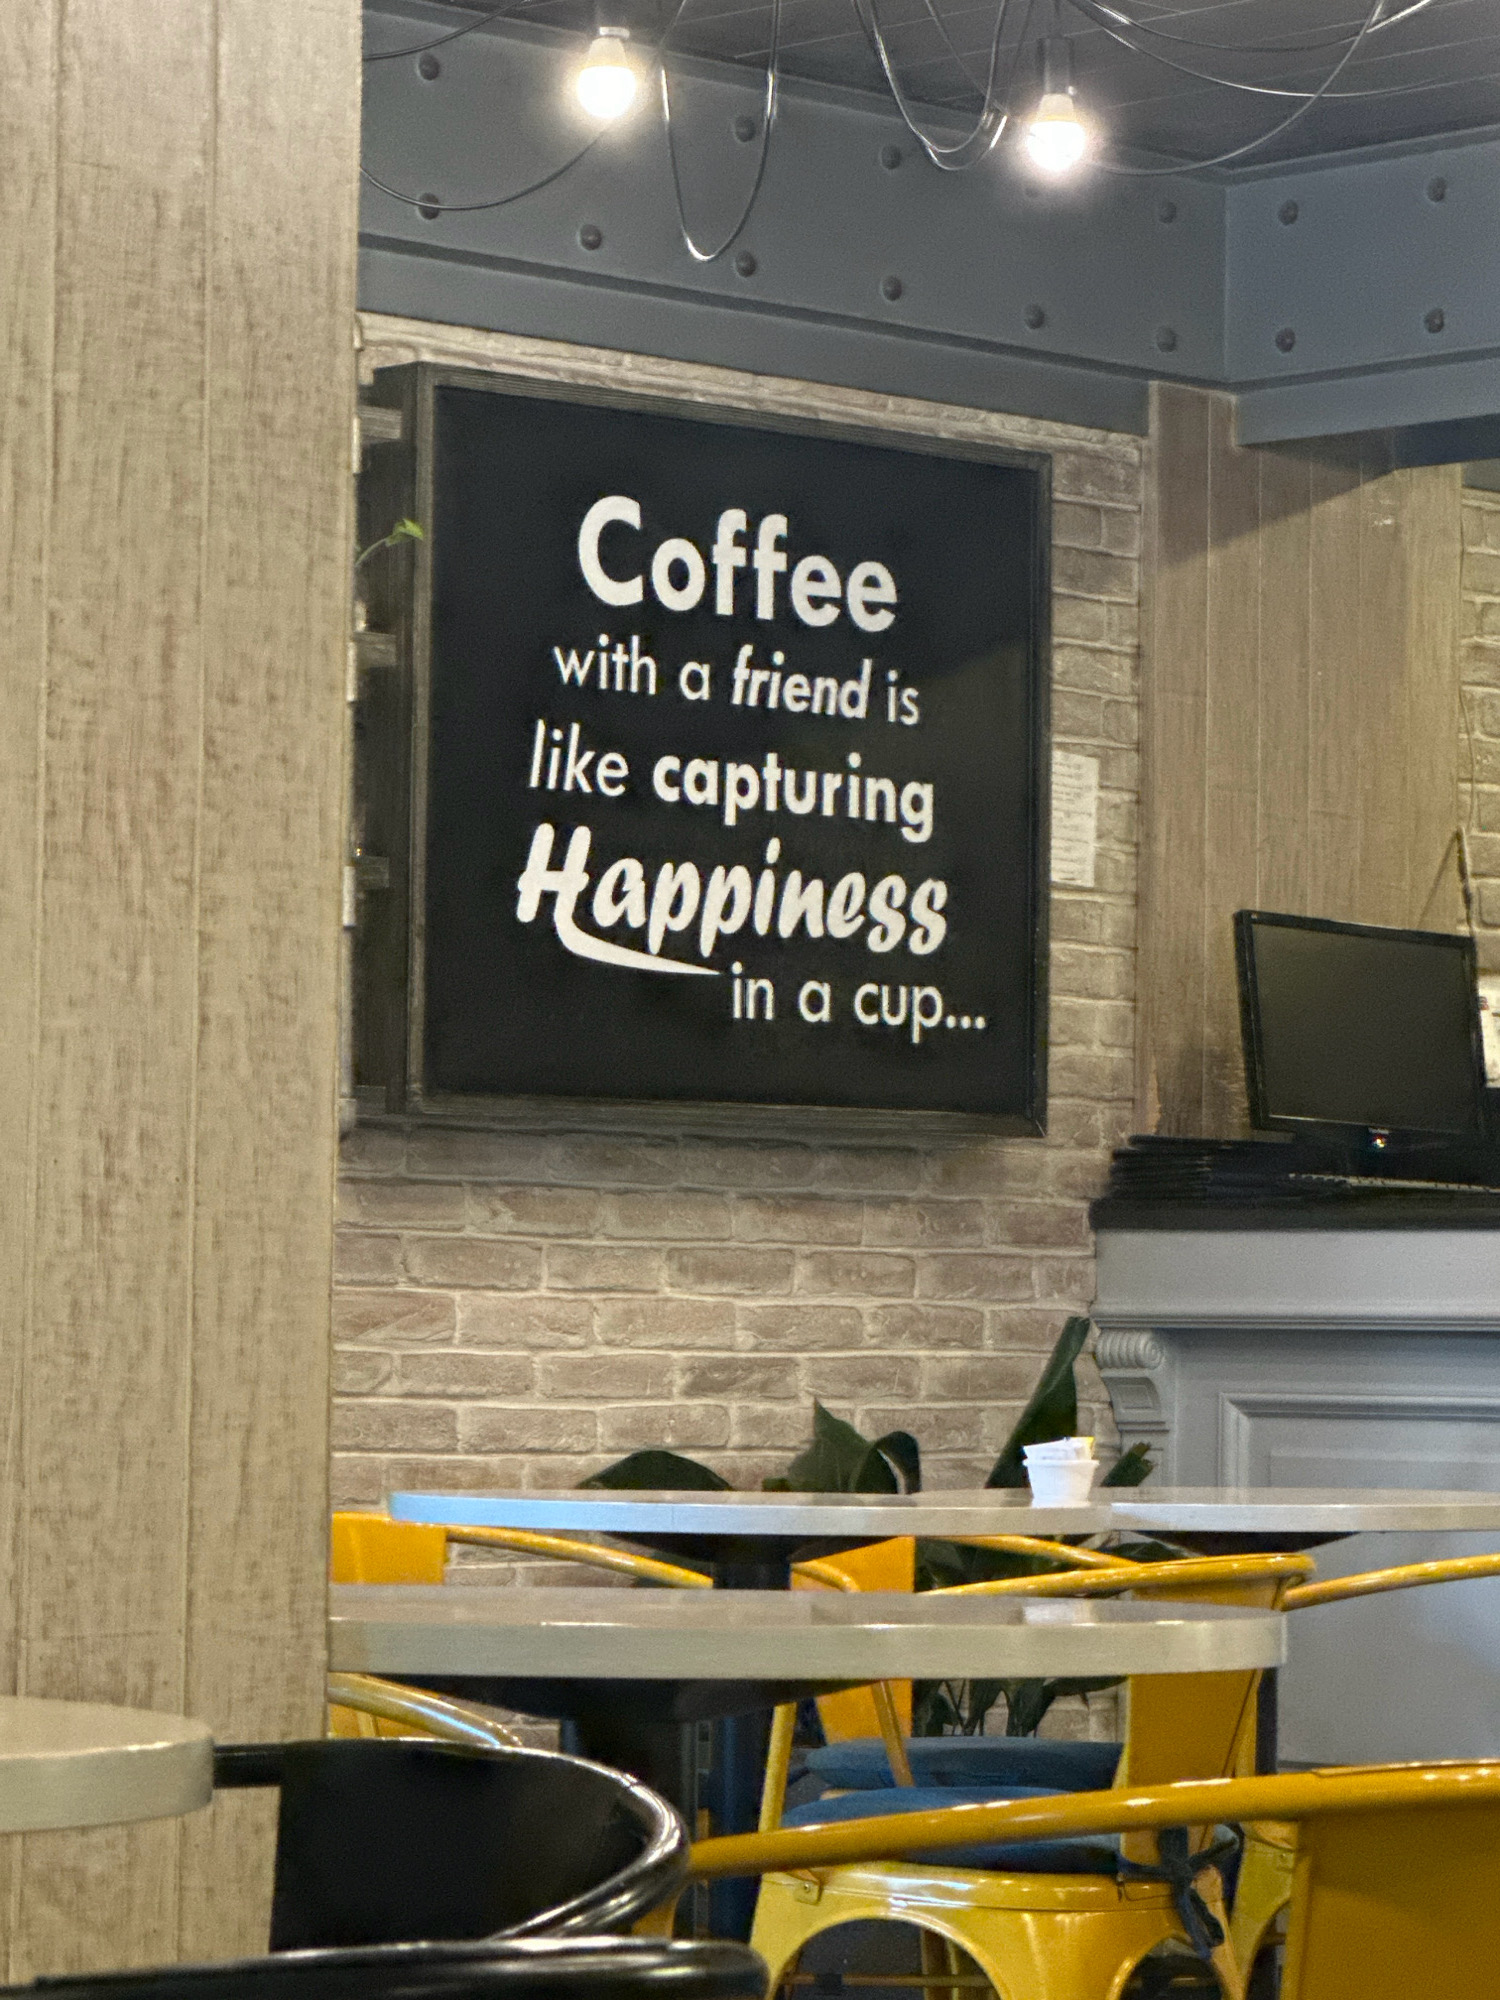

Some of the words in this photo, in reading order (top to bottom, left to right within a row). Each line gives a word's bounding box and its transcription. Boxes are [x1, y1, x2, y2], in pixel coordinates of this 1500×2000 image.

[577, 494, 898, 633] Coffee
[553, 633, 657, 696] with
[679, 661, 711, 701] a
[731, 643, 873, 719] friend
[887, 669, 920, 726] is
[529, 718, 630, 797] like
[652, 751, 934, 844] capturing
[515, 822, 948, 976] Happiness
[731, 961, 775, 1021] in
[798, 980, 831, 1023] a
[853, 982, 986, 1044] cup...
